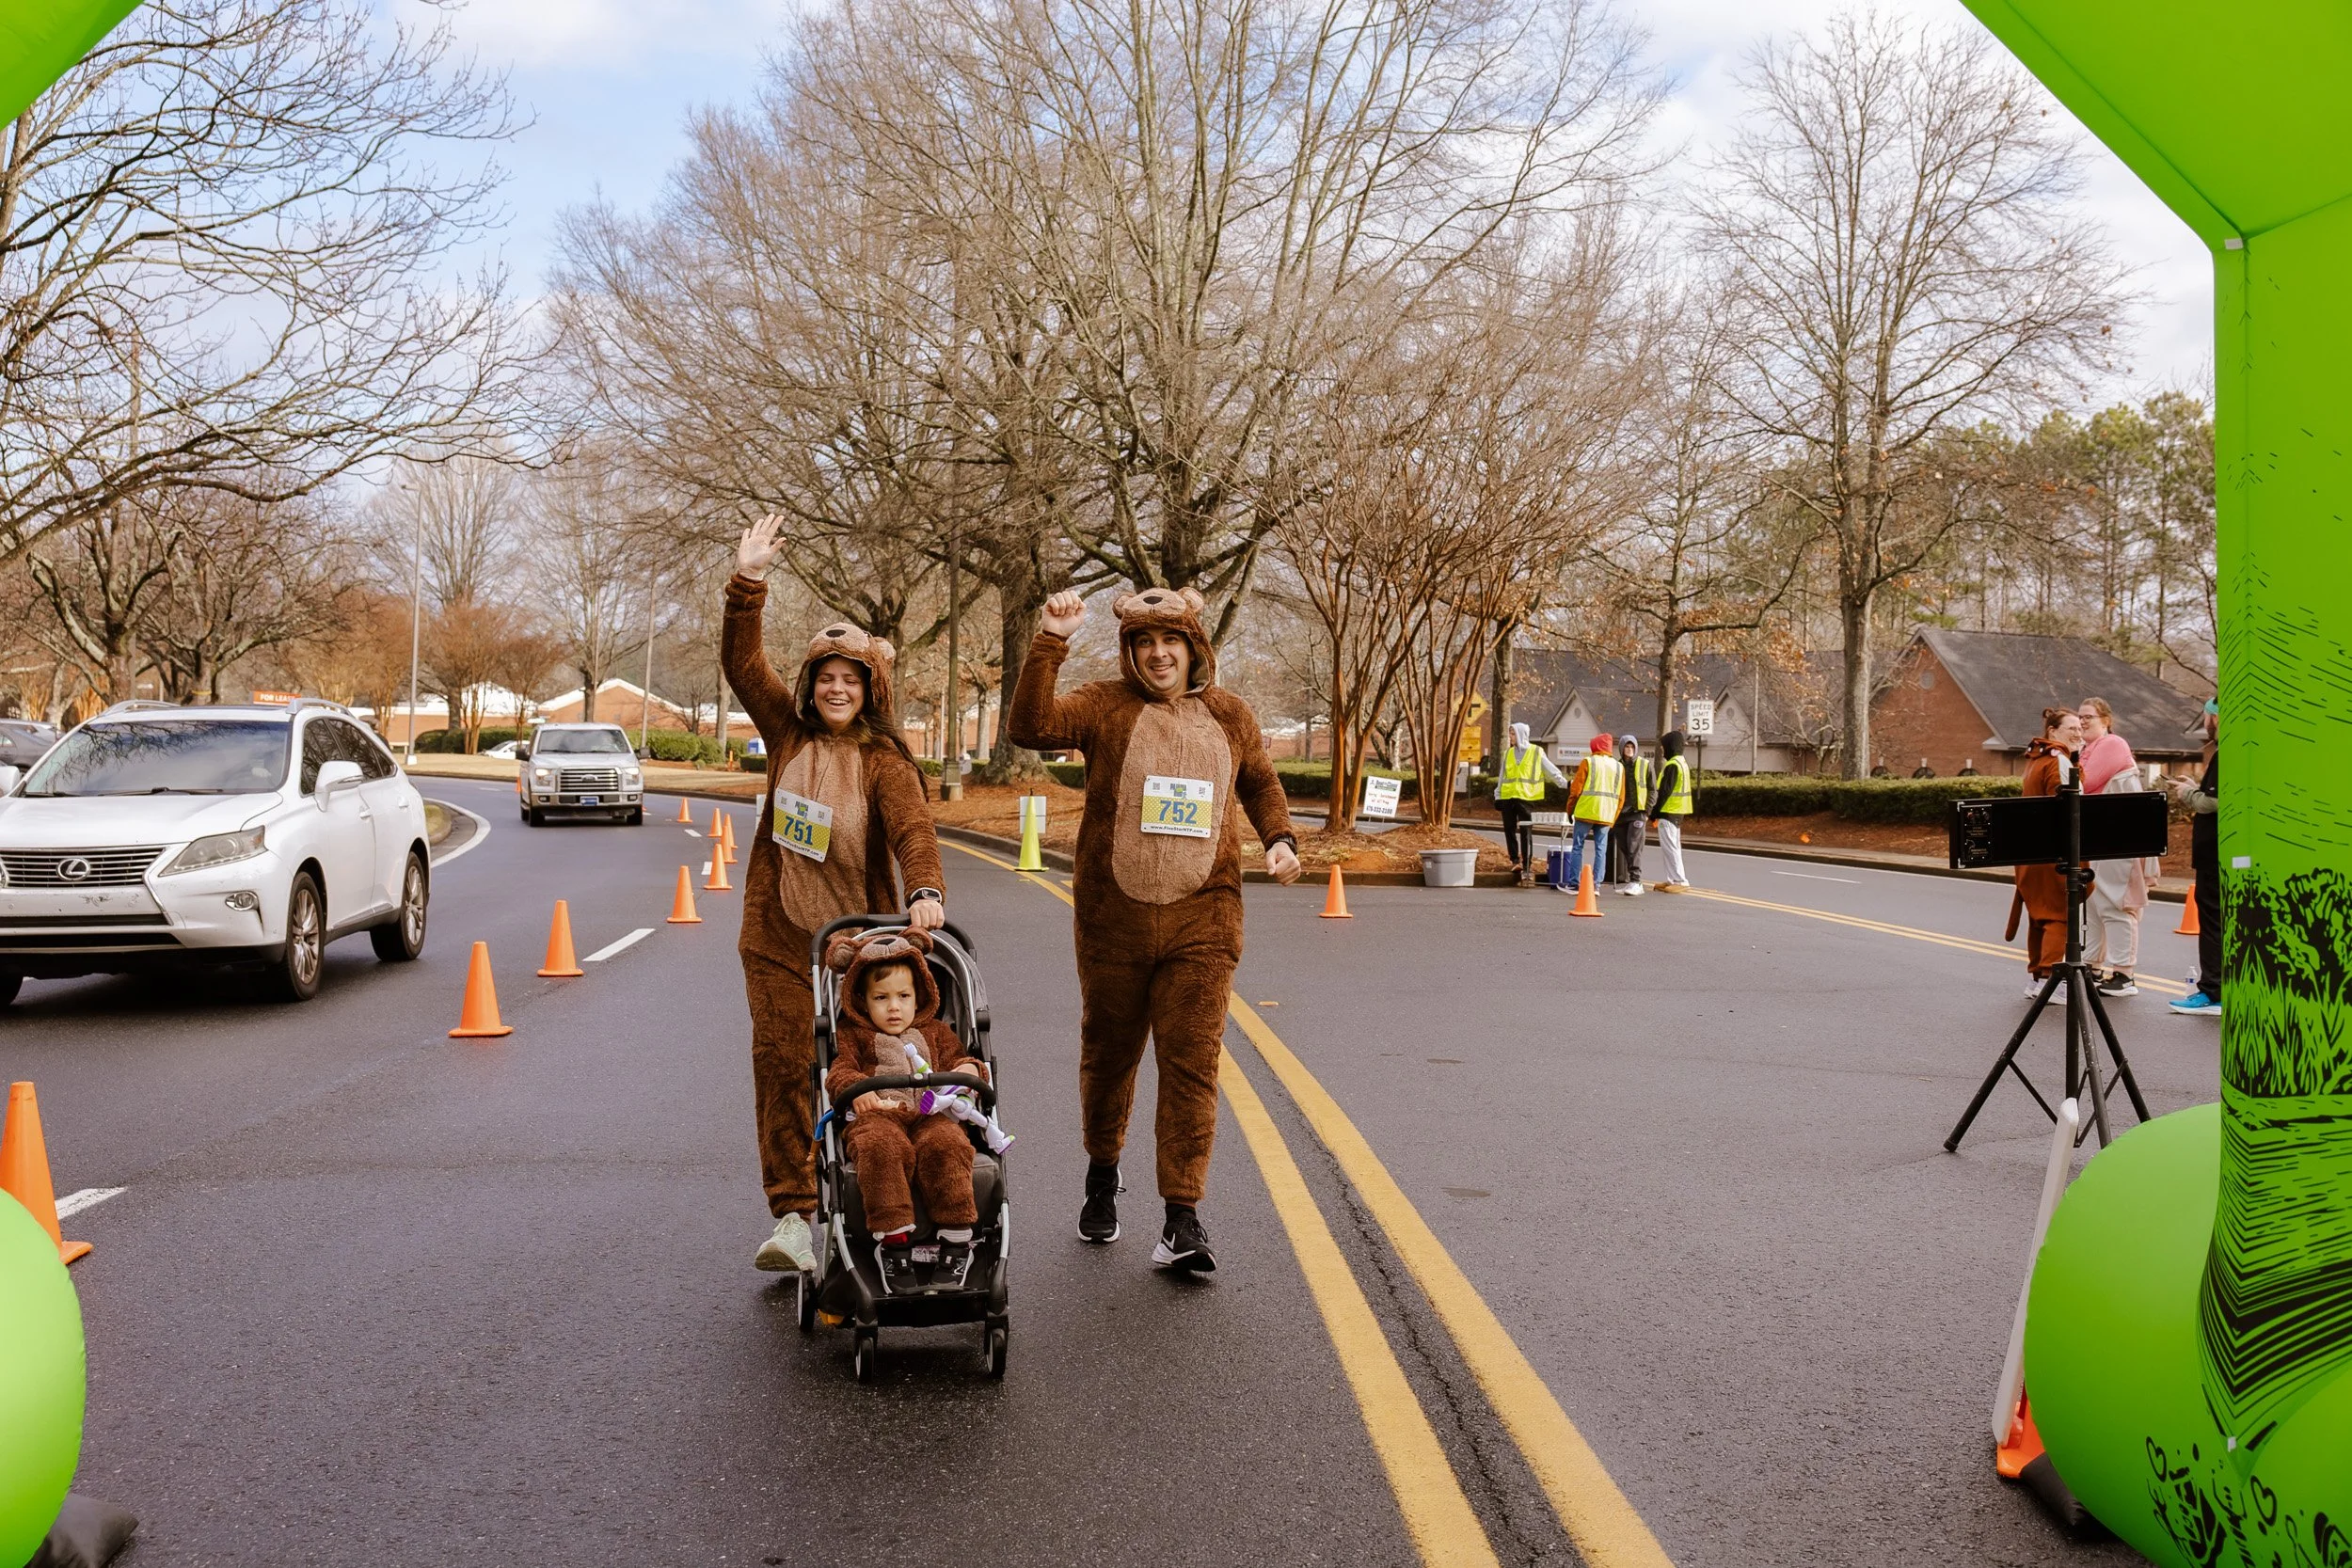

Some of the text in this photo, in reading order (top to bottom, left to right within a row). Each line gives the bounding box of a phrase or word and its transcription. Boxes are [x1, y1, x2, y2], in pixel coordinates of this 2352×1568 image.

[1692, 719, 1710, 731] 35
[1158, 800, 1198, 824] 752
[784, 815, 813, 846] 751
